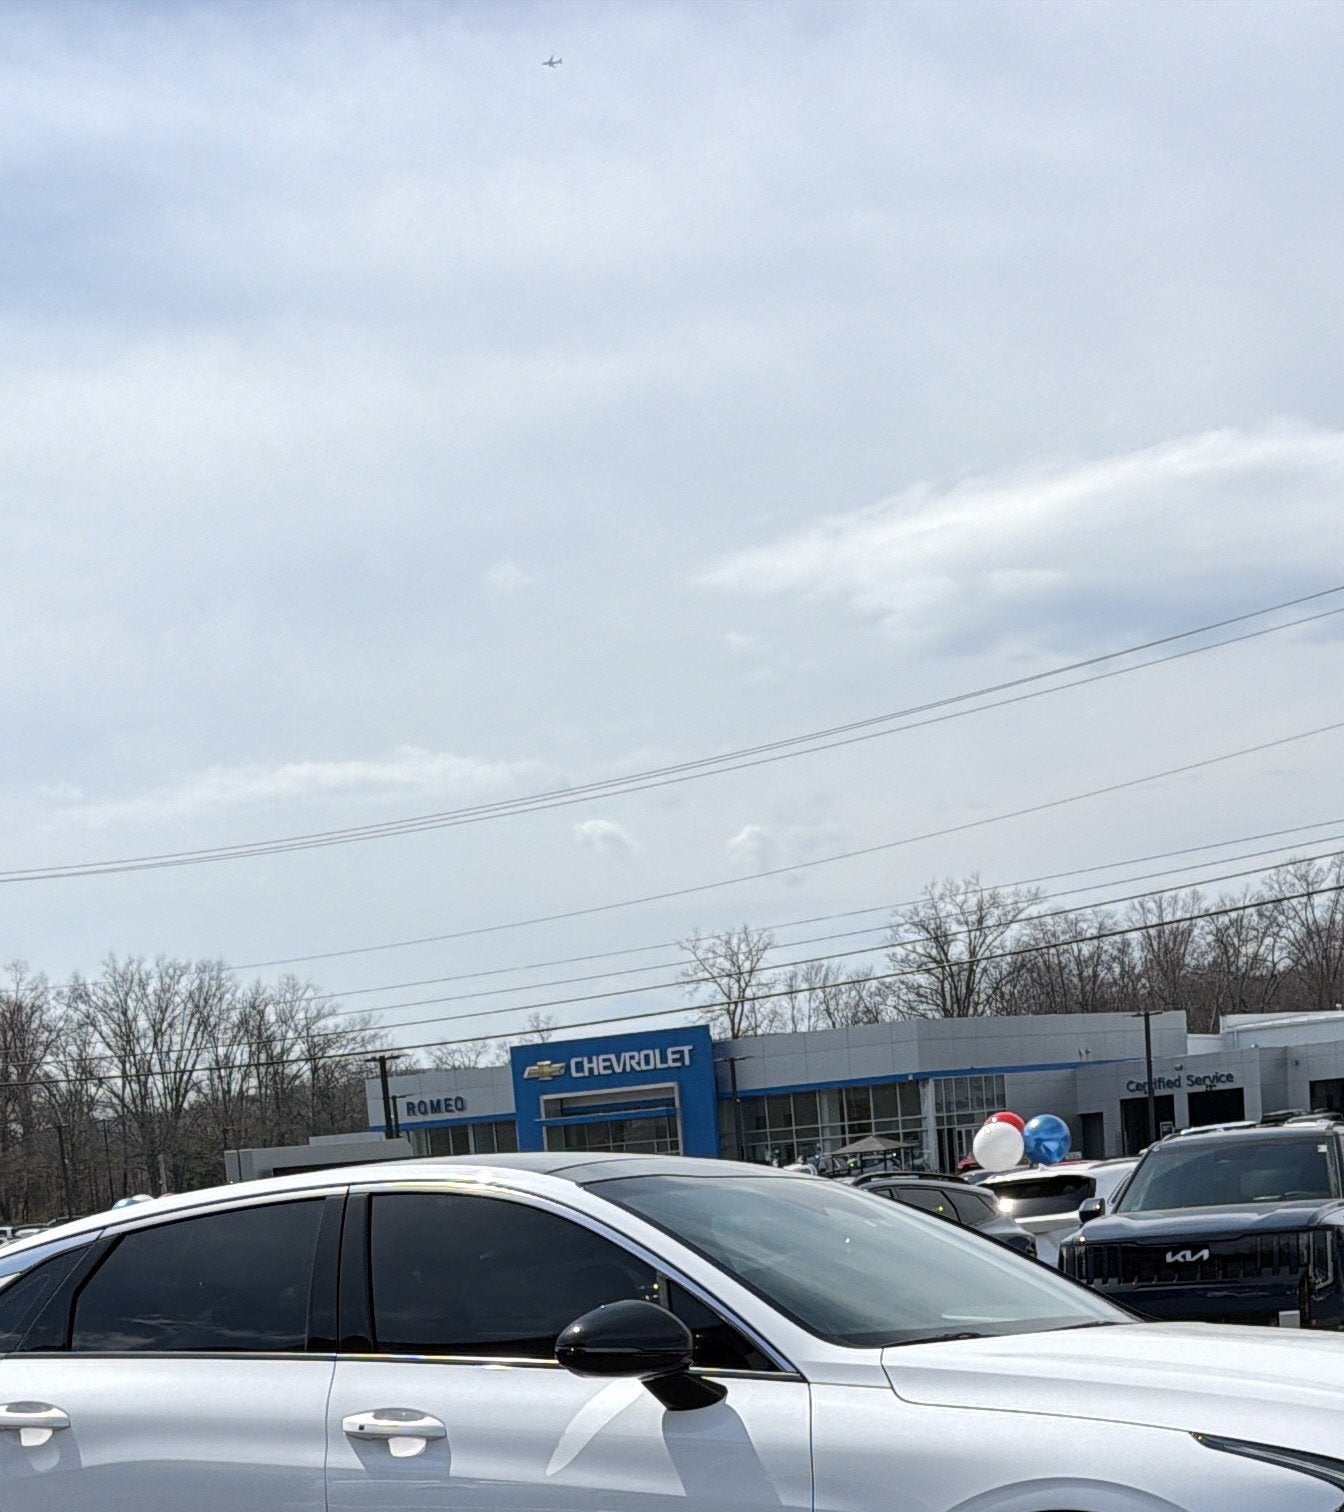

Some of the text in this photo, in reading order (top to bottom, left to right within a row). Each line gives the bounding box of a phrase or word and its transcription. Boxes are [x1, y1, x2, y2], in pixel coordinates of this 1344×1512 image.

[570, 1045, 693, 1078] CHEVROLET
[1186, 1072, 1234, 1088] Service
[406, 1096, 465, 1116] ROMEO
[1166, 1249, 1209, 1263] KIA
